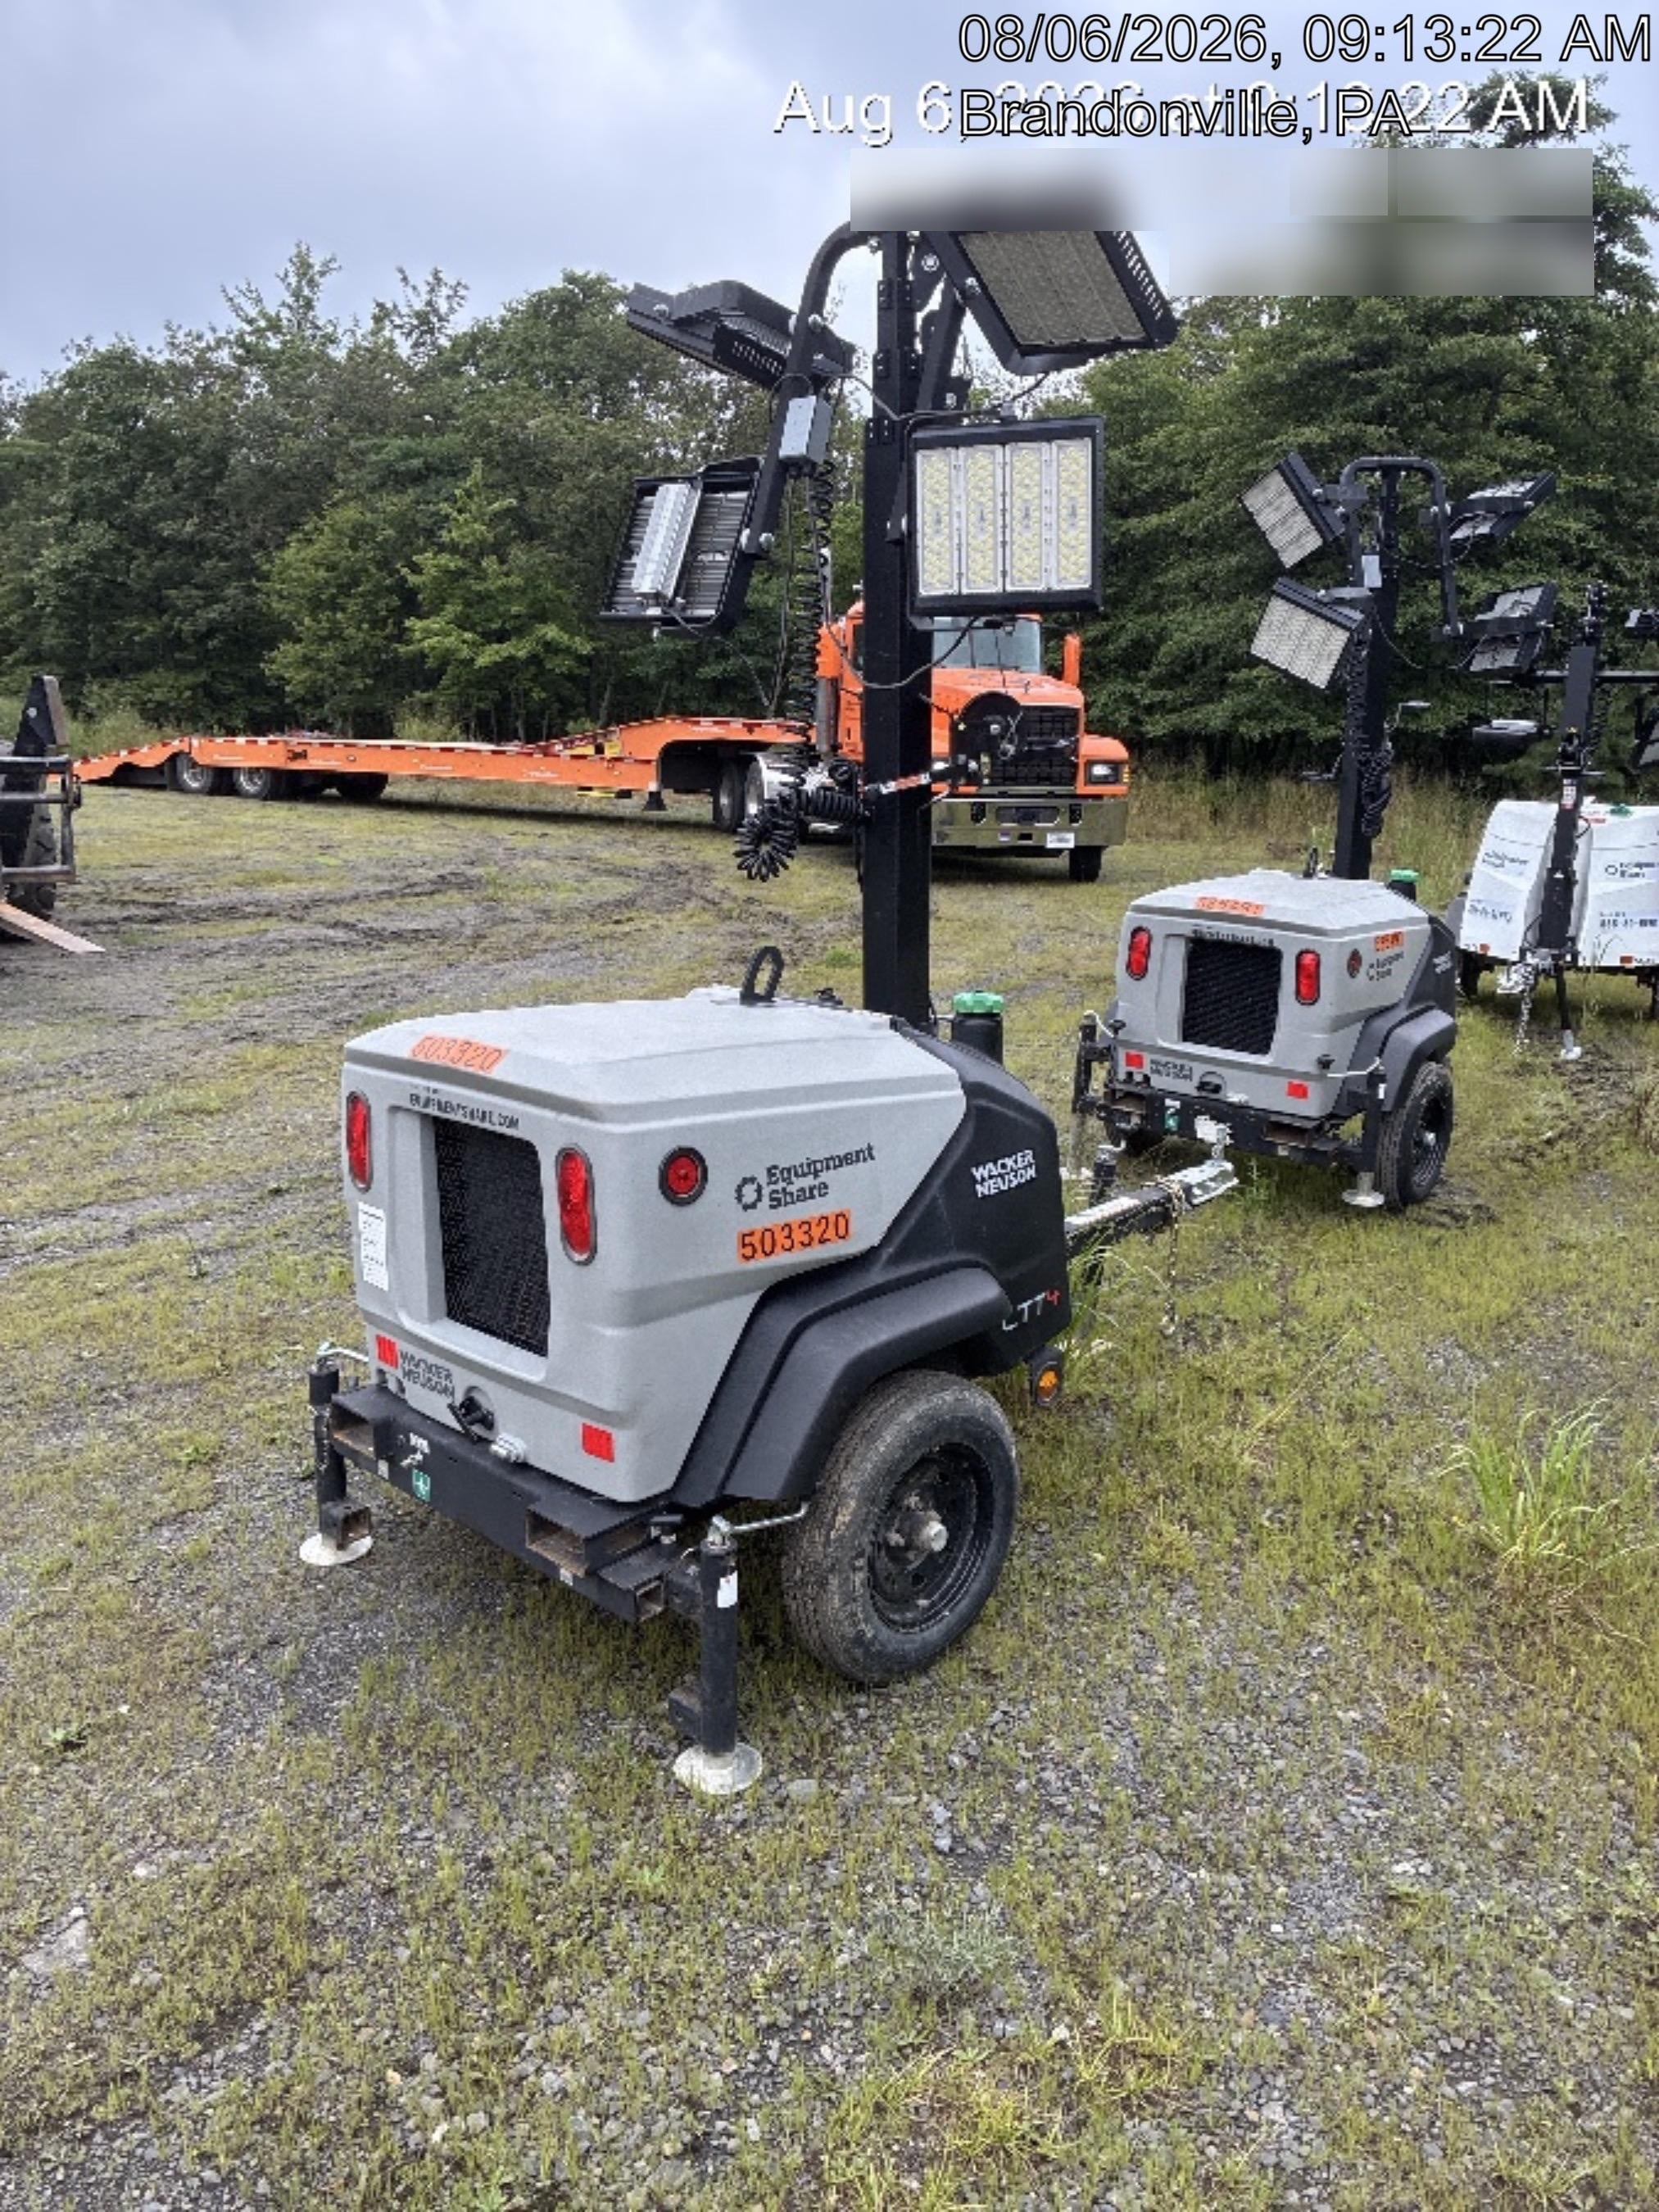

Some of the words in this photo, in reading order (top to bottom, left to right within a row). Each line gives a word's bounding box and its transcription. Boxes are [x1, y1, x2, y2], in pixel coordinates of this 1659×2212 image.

[766, 1142, 875, 1186] Equipment
[970, 1149, 1036, 1182] WACKER
[975, 1164, 1037, 1199] NEUSON
[768, 1181, 829, 1211] Share
[741, 1212, 850, 1261] 503320
